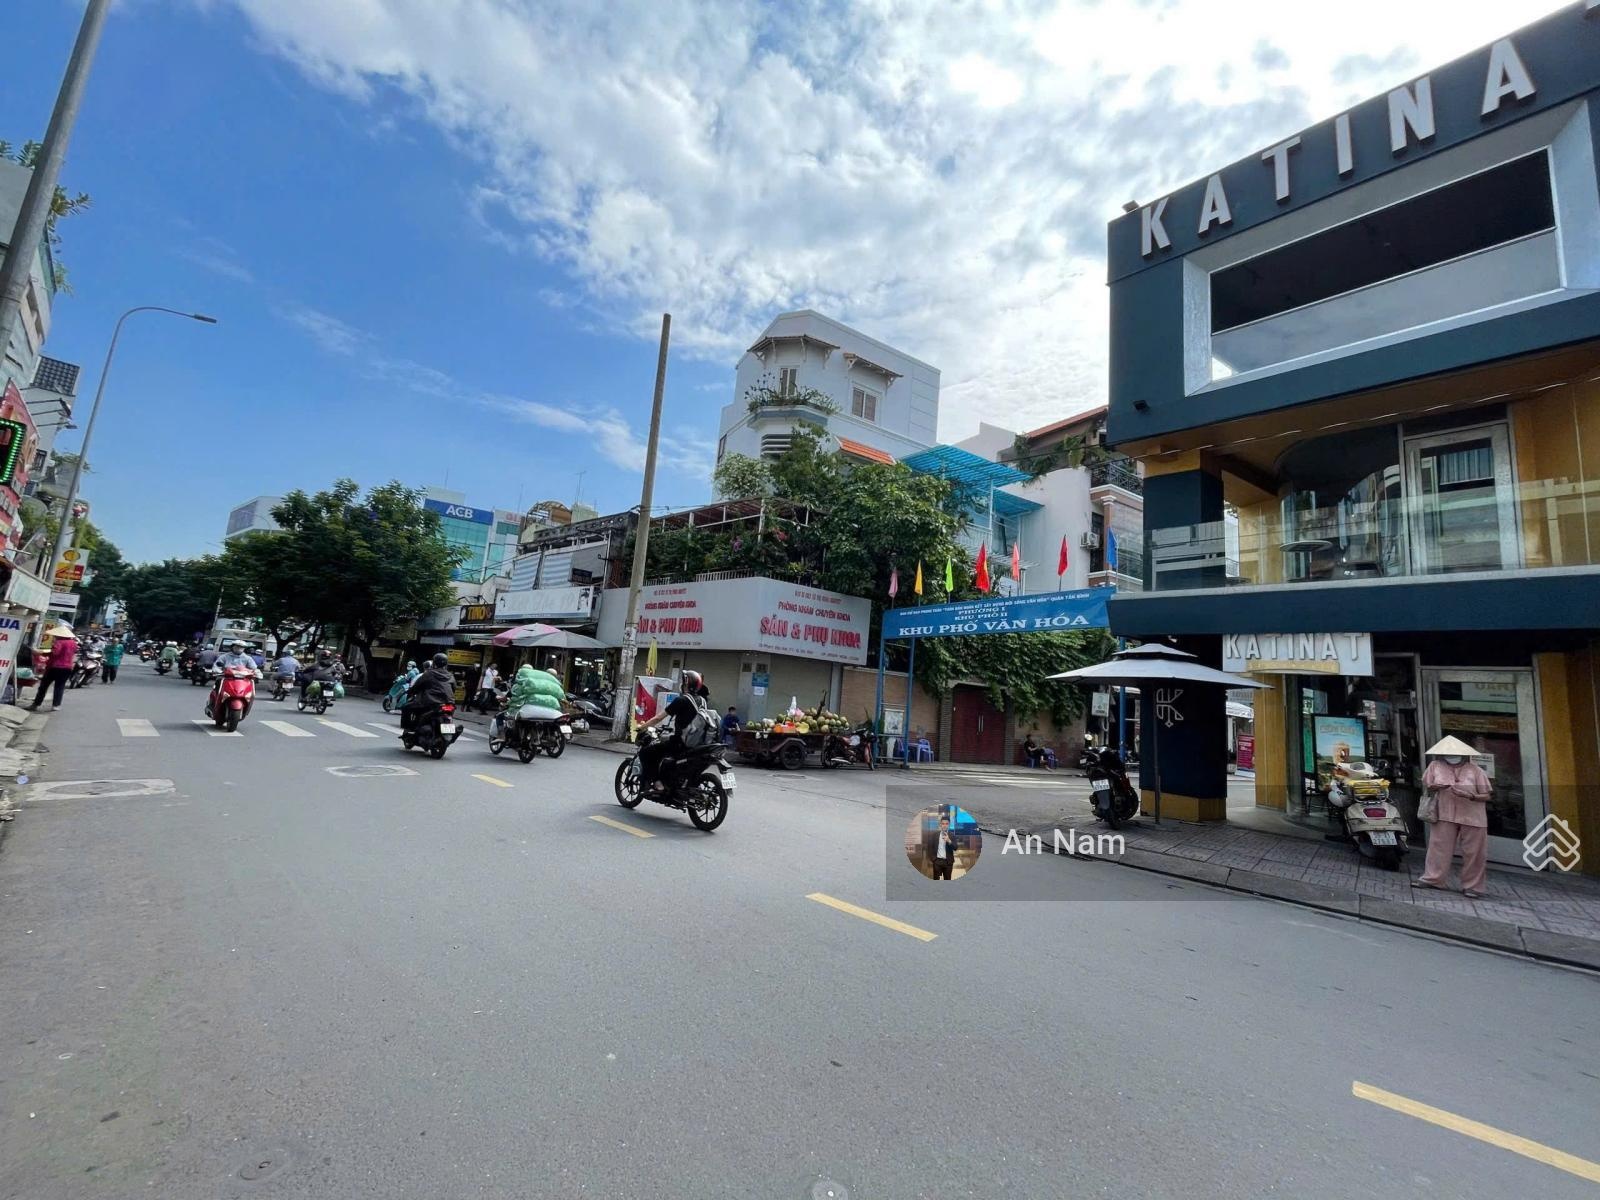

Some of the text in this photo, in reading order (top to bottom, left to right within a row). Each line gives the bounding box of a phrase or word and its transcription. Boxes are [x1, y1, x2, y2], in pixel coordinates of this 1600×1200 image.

[1141, 0, 1600, 257] KATINA
[445, 504, 473, 519] ACB
[791, 622, 801, 640] &
[804, 624, 829, 646] PHỤ
[830, 628, 862, 649] KHOA
[899, 611, 1090, 636] KHU PHỐ VĂN HÓA
[1225, 632, 1365, 661] KATINAT
